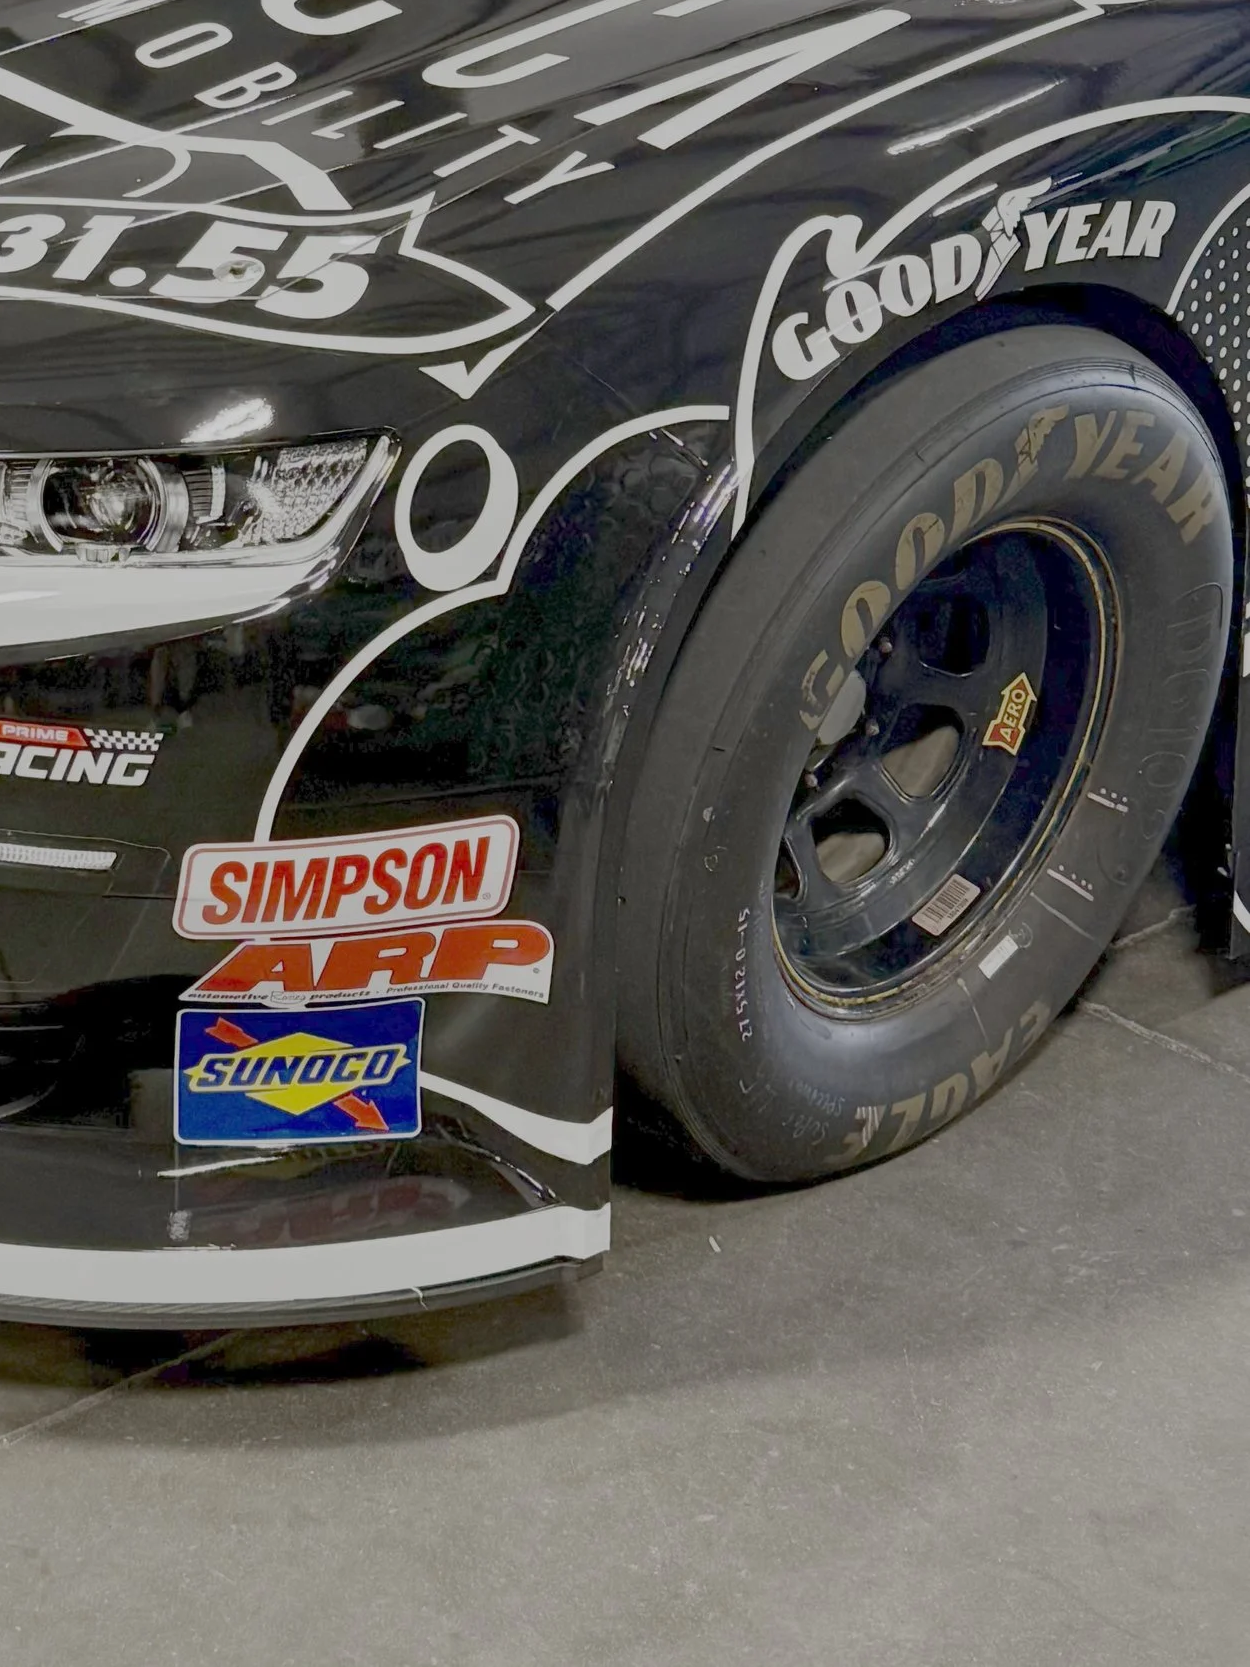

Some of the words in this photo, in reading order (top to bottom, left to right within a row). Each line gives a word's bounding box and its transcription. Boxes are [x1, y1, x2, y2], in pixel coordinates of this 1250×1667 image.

[1, 724, 69, 742] PRIME
[999, 686, 1027, 742] AERO
[202, 837, 488, 926] SIMPSON
[194, 927, 550, 992] ARP
[309, 989, 371, 1002] products
[386, 982, 449, 994] Professional
[452, 982, 489, 991] Quality
[492, 983, 545, 999] Fasteners
[194, 1048, 402, 1088] SUNOCO
